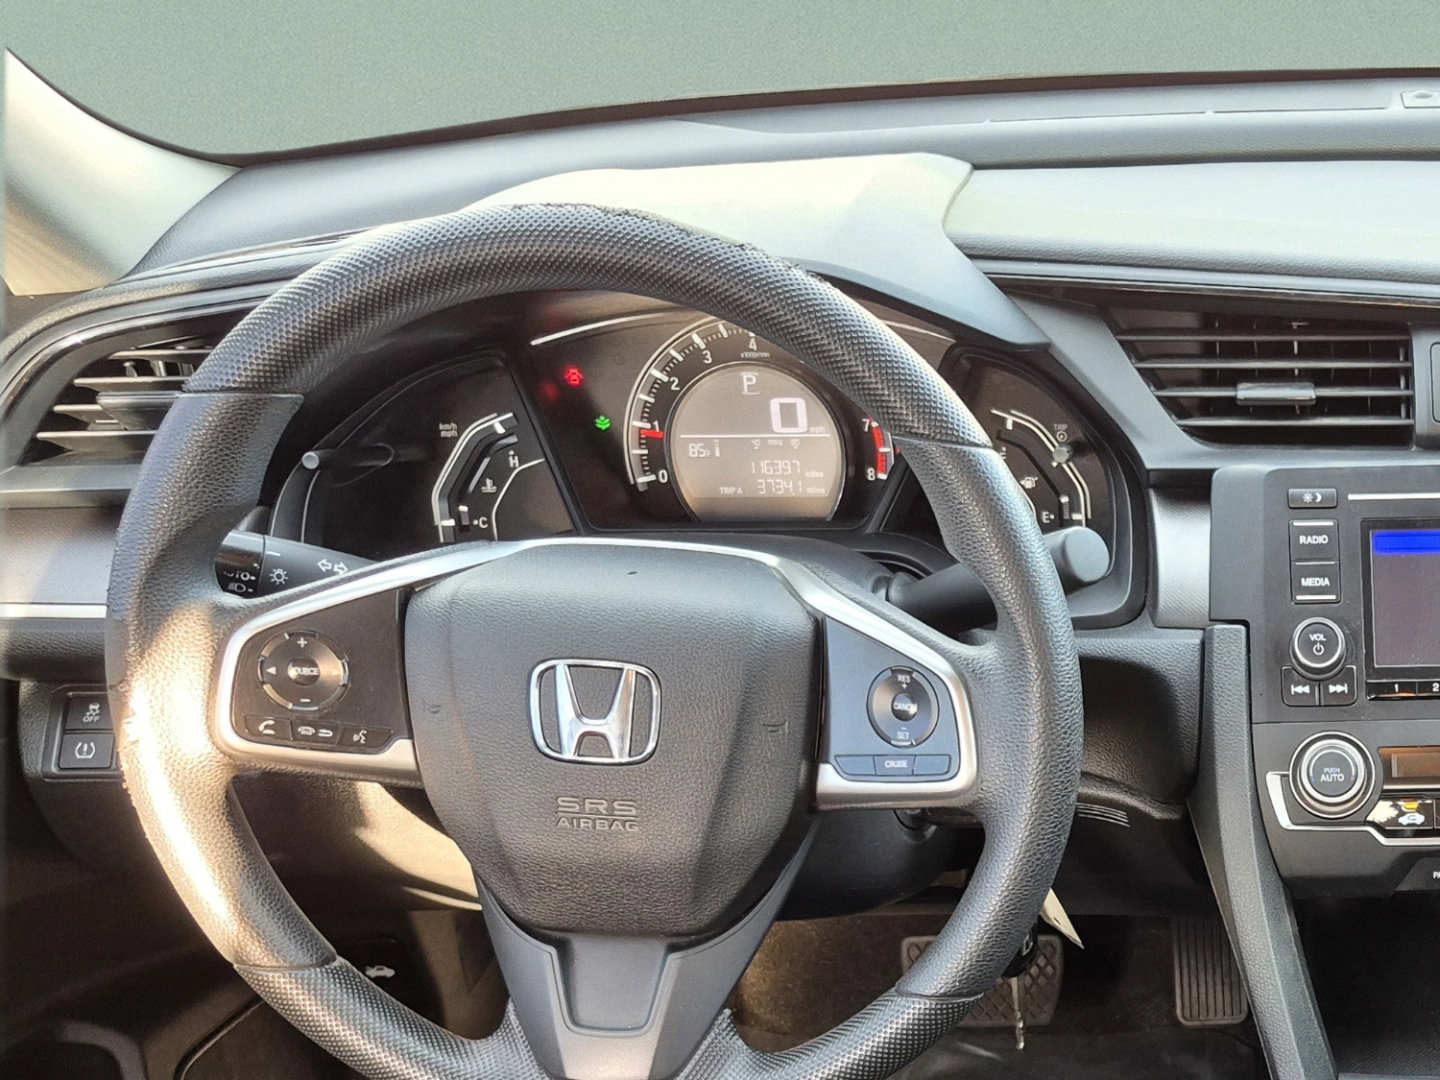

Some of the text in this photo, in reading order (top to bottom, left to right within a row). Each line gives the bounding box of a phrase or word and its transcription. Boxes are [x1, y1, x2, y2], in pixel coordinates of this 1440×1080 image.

[749, 338, 757, 350] 4
[703, 350, 713, 364] 3
[670, 377, 680, 391] 2
[742, 374, 757, 393] P
[770, 398, 826, 434] 0 mph
[653, 420, 660, 432] 1
[862, 418, 870, 432] 7
[1054, 423, 1068, 431] TRIP
[509, 455, 519, 468] H
[751, 460, 801, 475] 116397
[658, 470, 668, 483] 0
[867, 467, 876, 481] 8
[478, 516, 489, 528] C
[1041, 511, 1050, 523] E
[1299, 535, 1329, 545] RADIO
[1301, 577, 1330, 587] MEDIA
[1309, 633, 1326, 641] VOL
[897, 674, 911, 682] RES
[1394, 683, 1399, 693] 1
[1432, 682, 1440, 691] 2
[893, 703, 917, 713] CANC
[896, 731, 909, 740] SET
[884, 760, 908, 768] CRUISE
[1320, 773, 1344, 782] AUTO
[557, 796, 638, 815] SRS
[556, 818, 639, 832] AIRBAG
